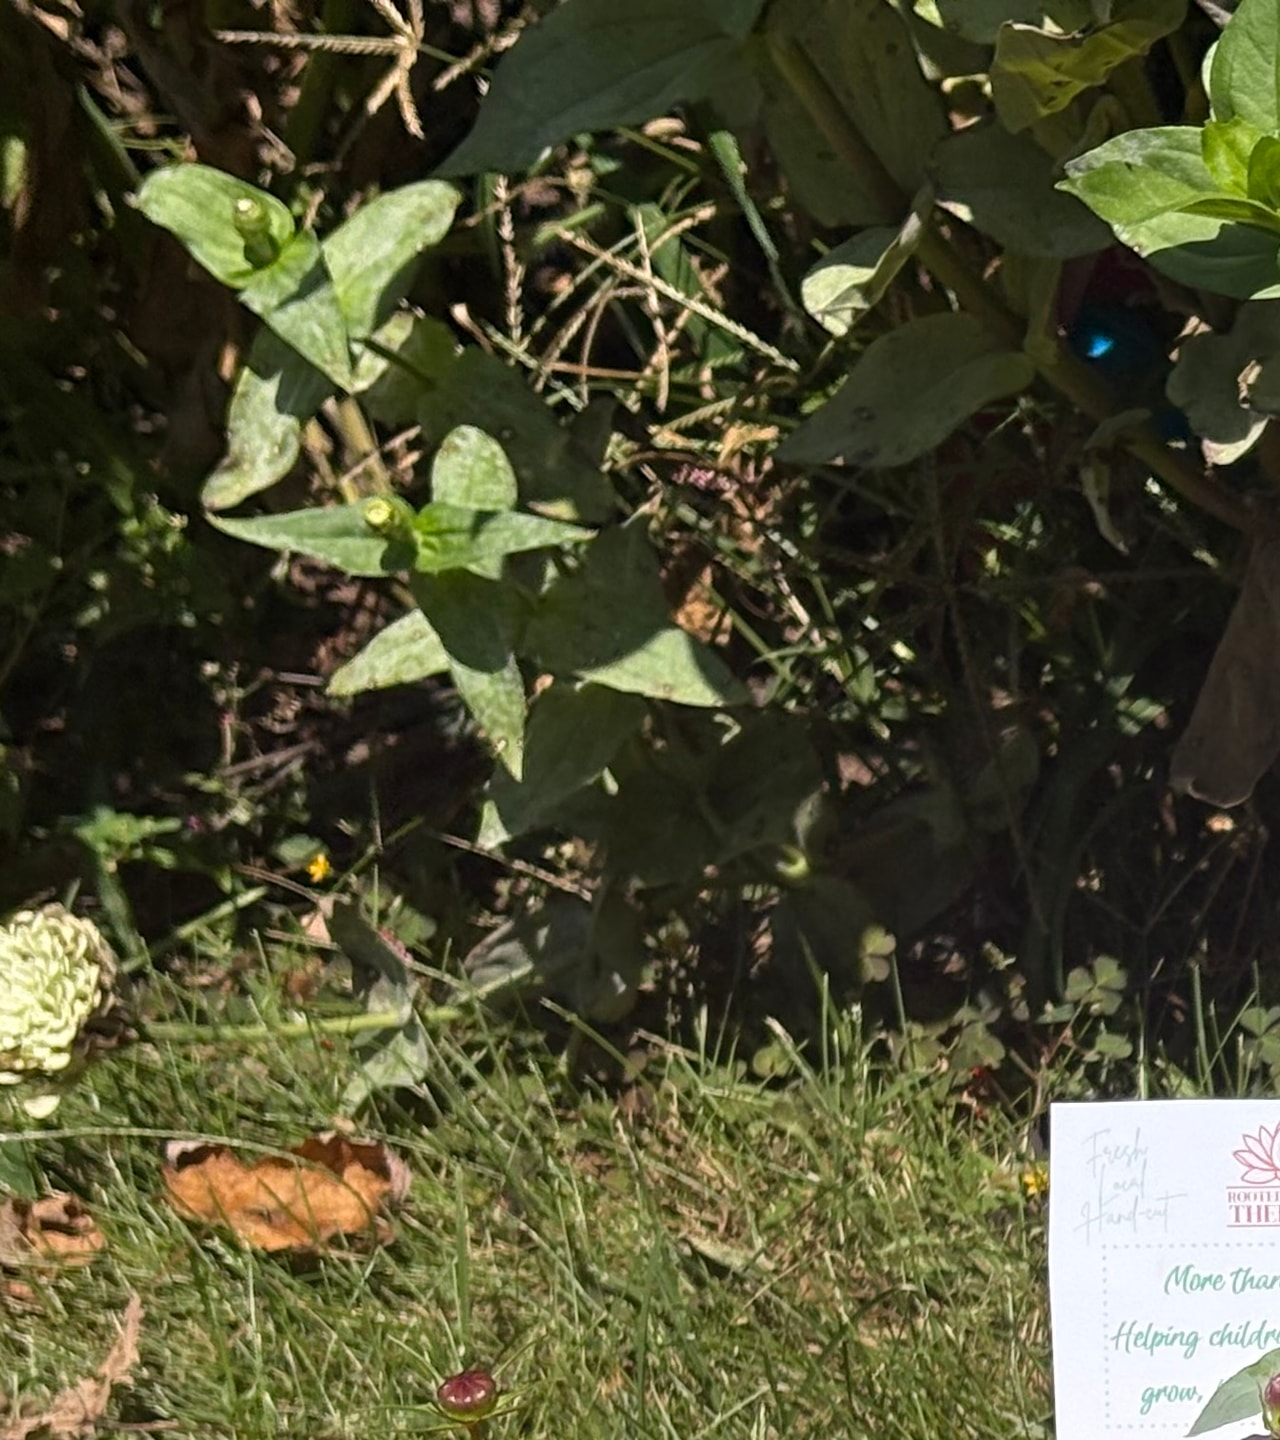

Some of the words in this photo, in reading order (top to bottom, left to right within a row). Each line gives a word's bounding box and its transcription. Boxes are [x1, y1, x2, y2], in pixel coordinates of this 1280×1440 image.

[1082, 1127, 1149, 1178] Fresh
[1163, 1264, 1225, 1295] More
[1111, 1320, 1201, 1359] Helping
[1140, 1383, 1203, 1415] grow,
